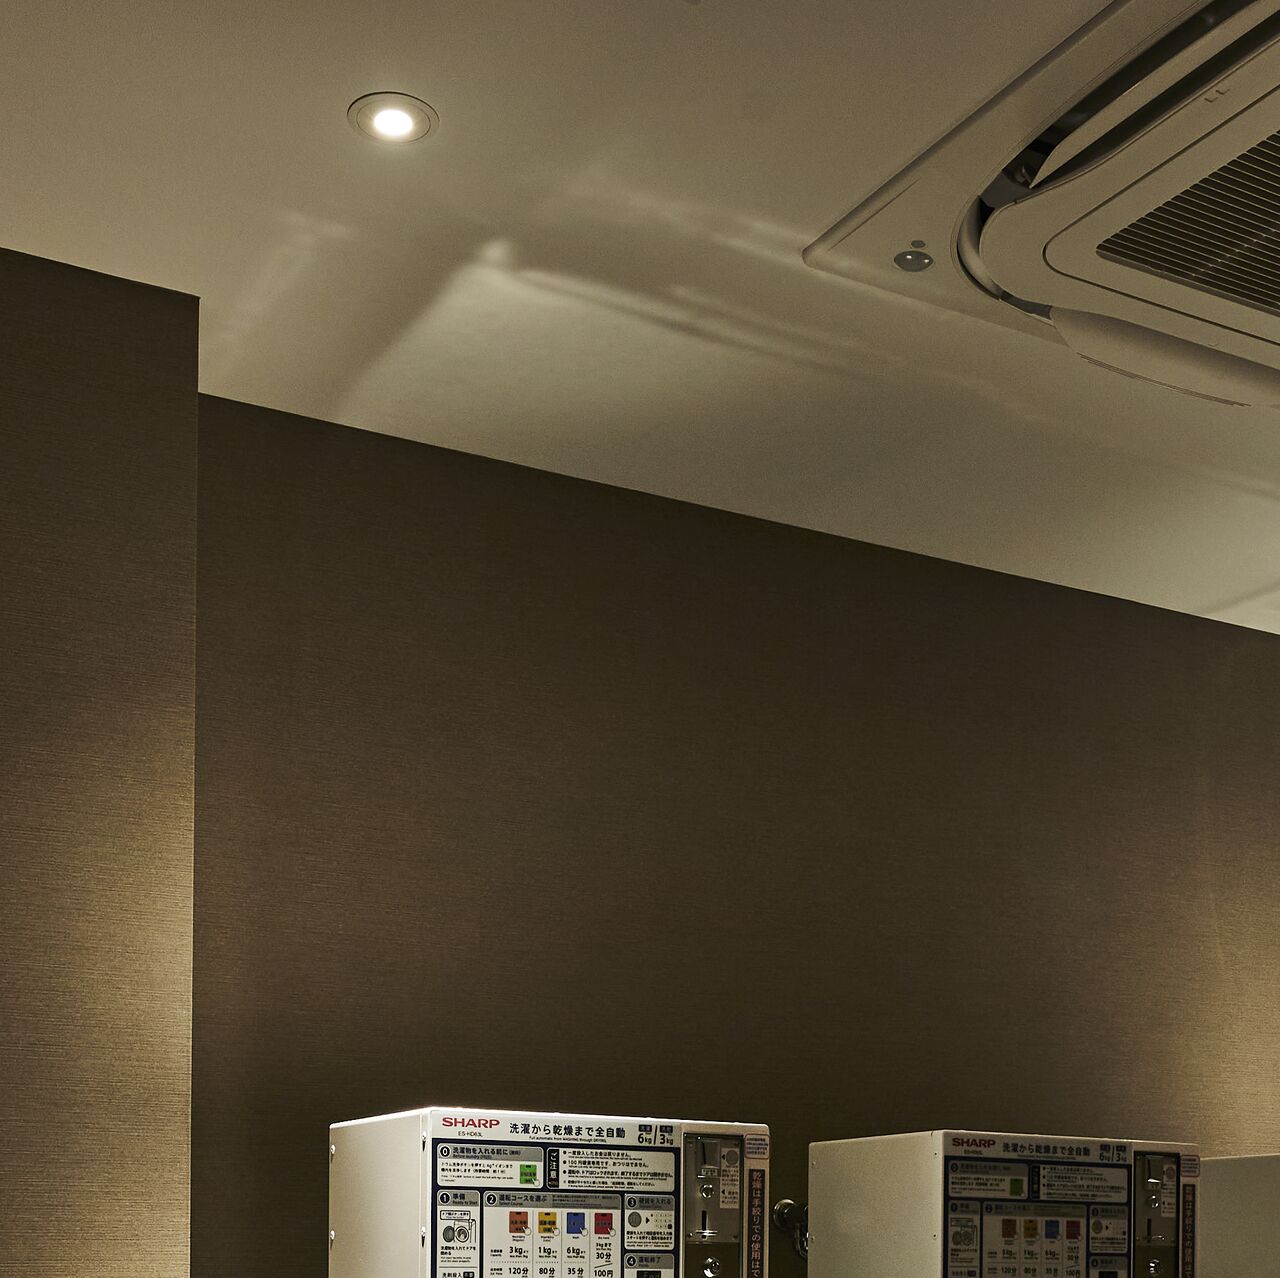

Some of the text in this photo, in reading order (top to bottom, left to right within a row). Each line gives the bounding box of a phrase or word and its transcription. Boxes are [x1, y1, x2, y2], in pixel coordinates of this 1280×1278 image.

[442, 1117, 500, 1128] SHARP
[509, 1122, 626, 1139] 洗濯から乾燥まで全自動
[952, 1138, 996, 1148] SHARP
[508, 1267, 529, 1275] 120分
[538, 1267, 555, 1275] 80分
